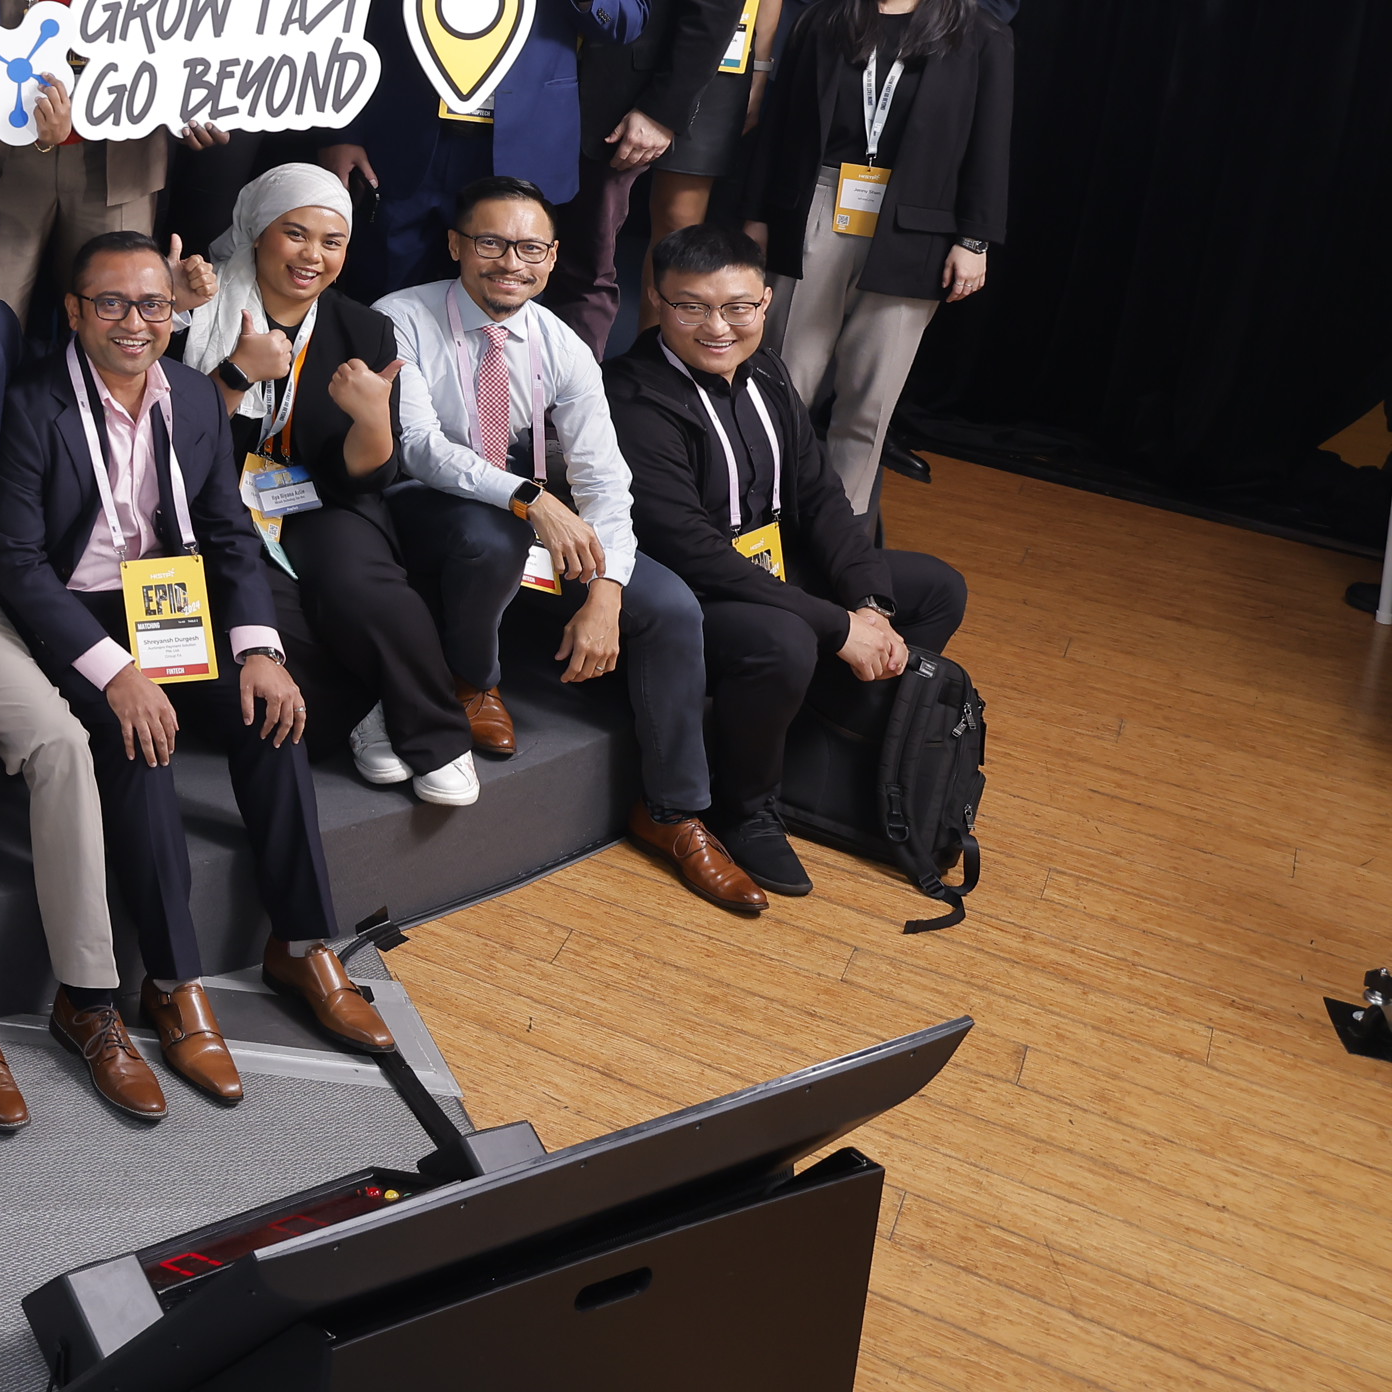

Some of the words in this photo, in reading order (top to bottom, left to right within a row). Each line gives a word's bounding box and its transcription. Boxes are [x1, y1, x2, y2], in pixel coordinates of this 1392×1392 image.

[85, 60, 157, 127] GO
[180, 40, 368, 124] BEYOND
[142, 582, 189, 616] EPIC
[137, 622, 160, 630] MATCHING
[143, 637, 174, 646] Shreyansh
[174, 635, 200, 645] Durgesh
[166, 667, 186, 675] FINTECH
